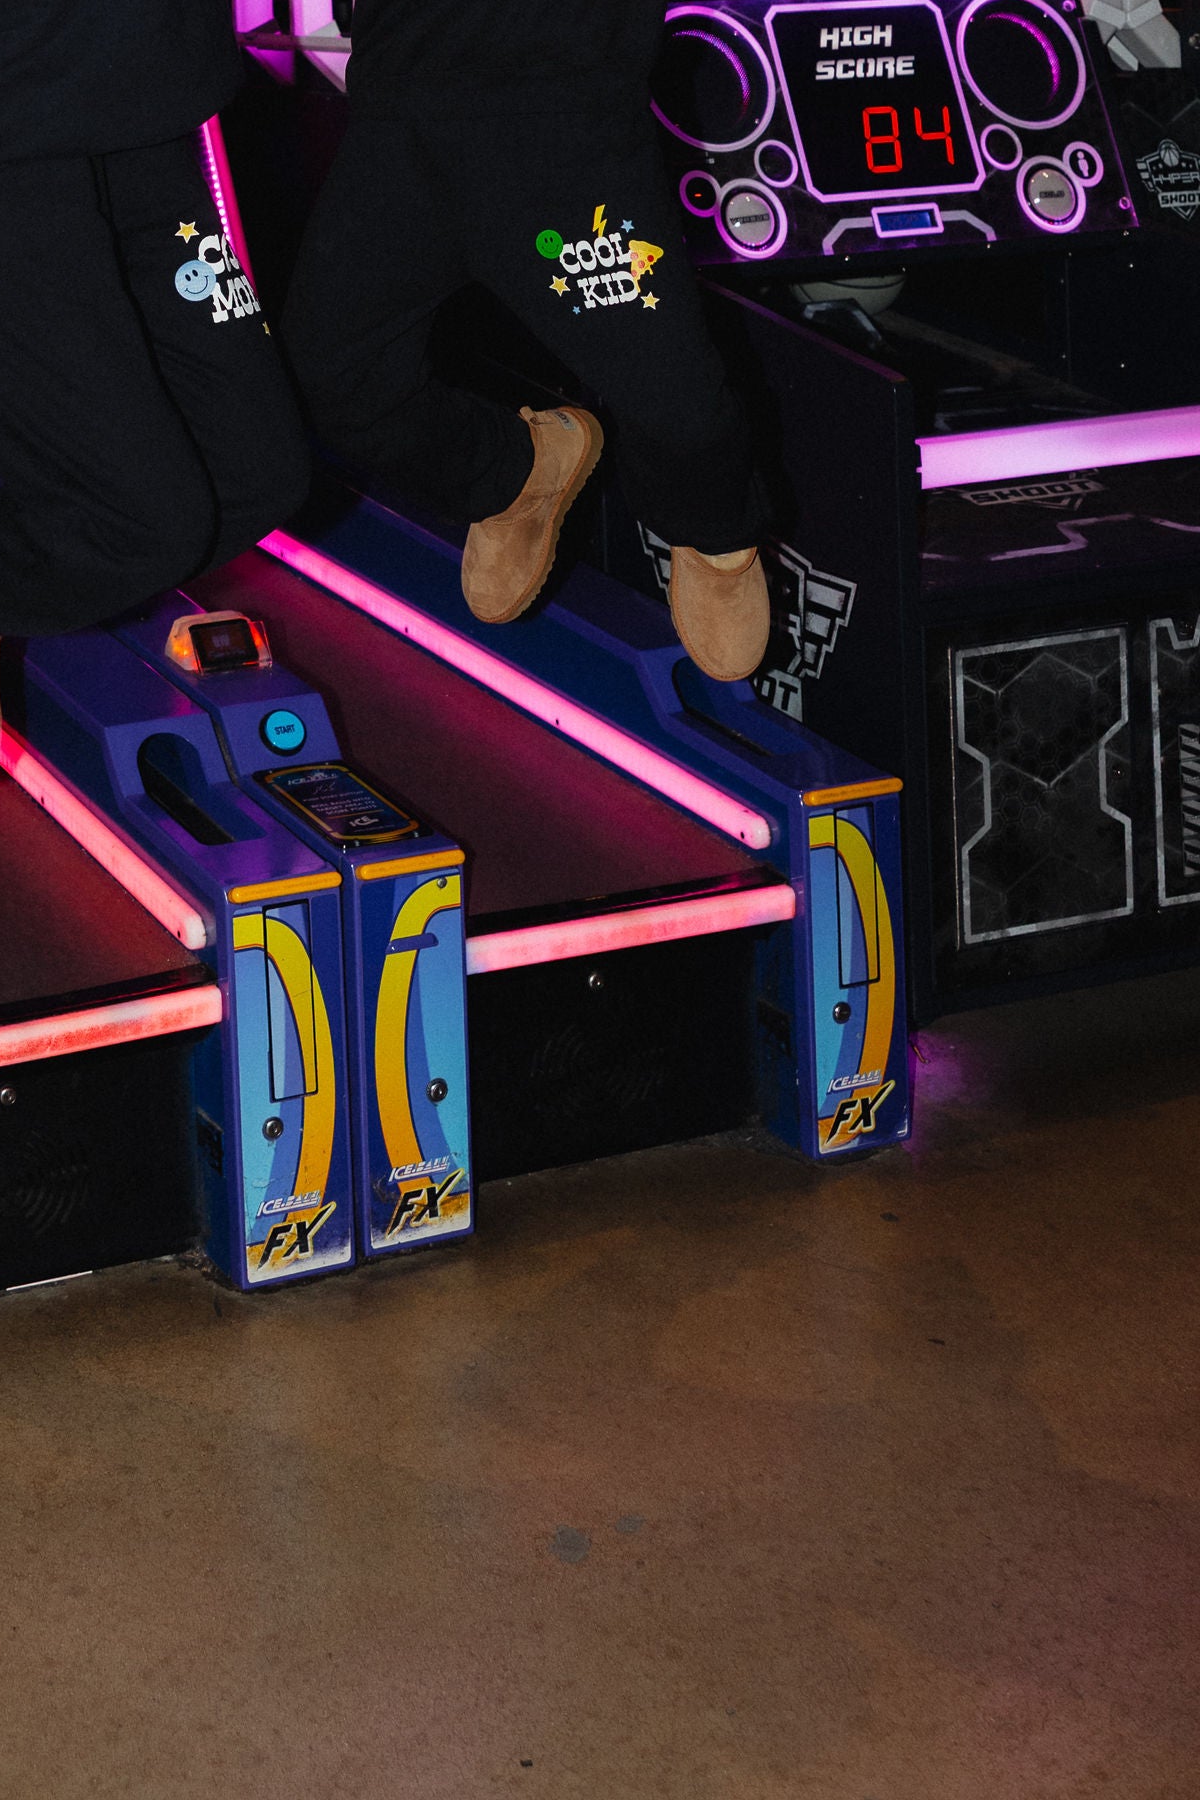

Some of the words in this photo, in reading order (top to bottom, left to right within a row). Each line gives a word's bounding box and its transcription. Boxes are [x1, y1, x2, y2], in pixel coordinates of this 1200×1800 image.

[819, 25, 893, 50] HIGH
[815, 55, 915, 81] SCORE
[863, 105, 955, 174] 84
[1161, 192, 1200, 206] SHOO
[559, 232, 633, 274] COOL
[577, 270, 639, 309] KID
[970, 480, 1091, 503] SHOOT
[274, 723, 296, 735] START
[349, 816, 379, 827] ICE
[826, 1081, 894, 1145] FX
[386, 1168, 464, 1239] FX
[257, 1201, 336, 1271] FX
